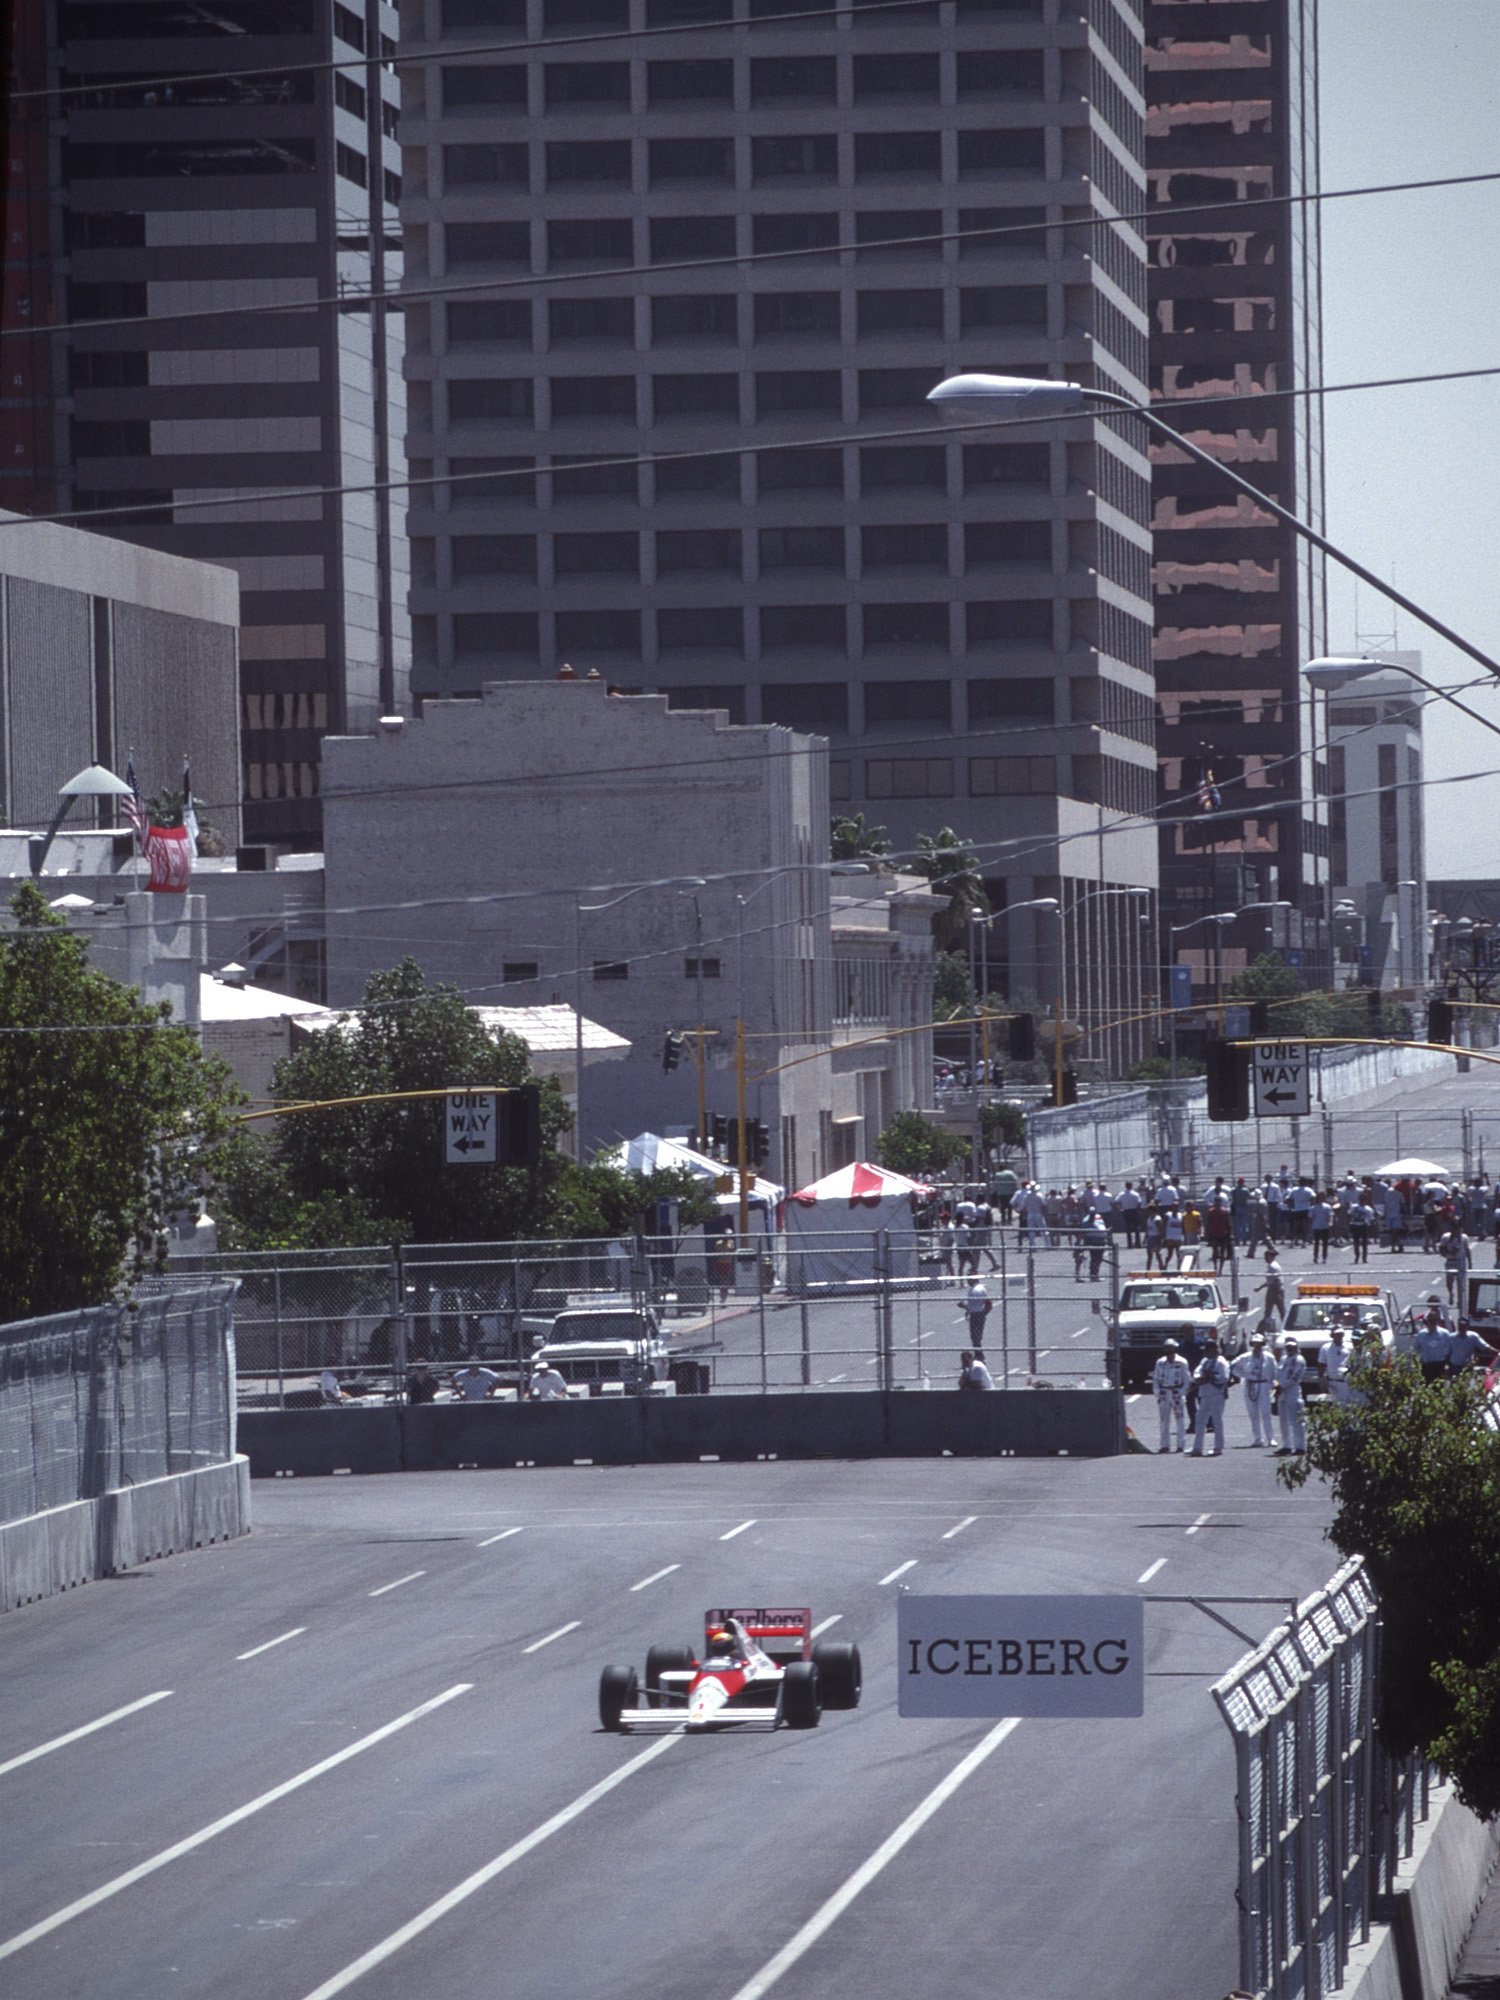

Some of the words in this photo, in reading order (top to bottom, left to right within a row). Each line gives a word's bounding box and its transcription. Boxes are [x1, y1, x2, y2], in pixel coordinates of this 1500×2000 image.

[1261, 1044, 1300, 1060] ONE
[1261, 1067, 1301, 1084] WAY
[452, 1094, 490, 1109] ONE
[451, 1115, 491, 1132] WAY
[908, 1638, 1129, 1676] ICEBERG
